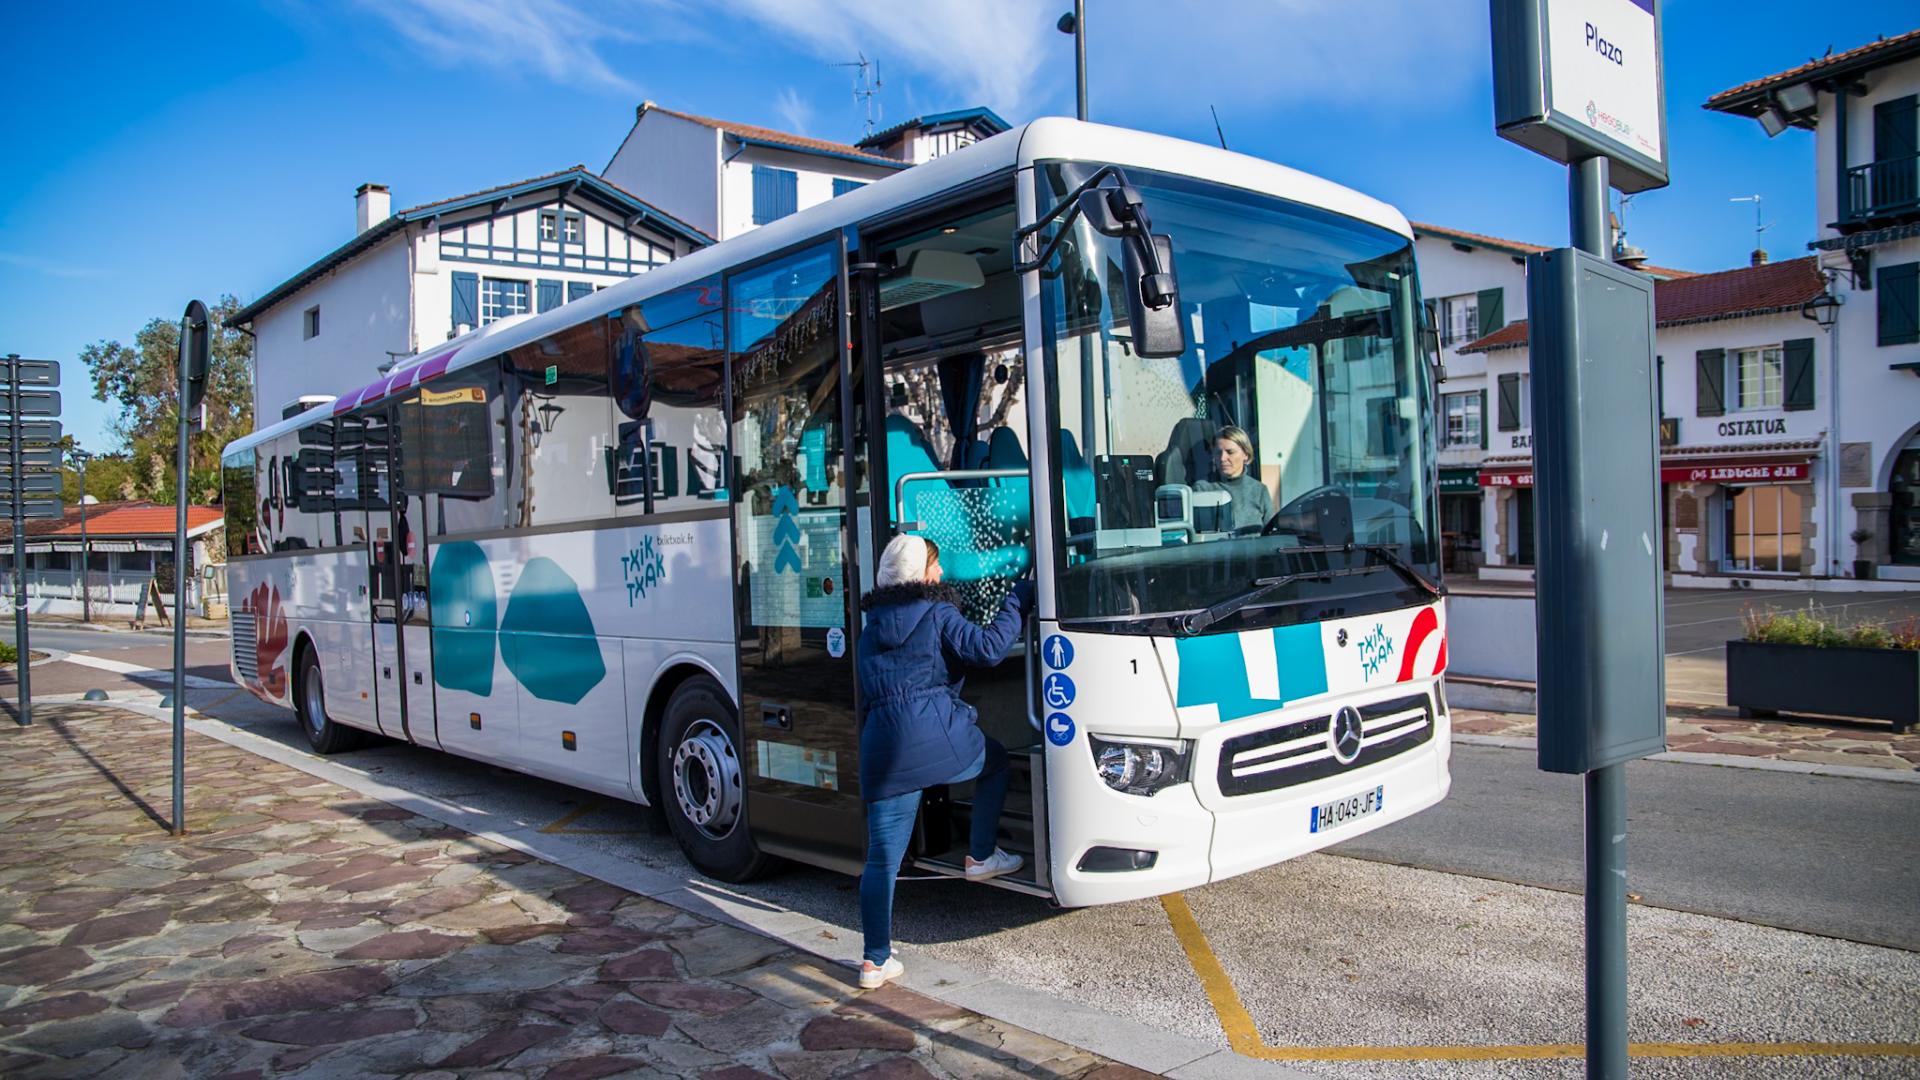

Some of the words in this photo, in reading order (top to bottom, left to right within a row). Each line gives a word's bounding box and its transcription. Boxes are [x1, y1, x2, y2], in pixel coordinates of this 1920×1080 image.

[1585, 21, 1623, 66] Plaza
[1718, 418, 1787, 436] OSTATUA
[1710, 467, 1770, 479] LADUCHE
[626, 553, 666, 608] TXAK
[1130, 659, 1137, 675] 1
[1362, 636, 1394, 683] TXAK
[1318, 791, 1375, 829] HA-049-JF
